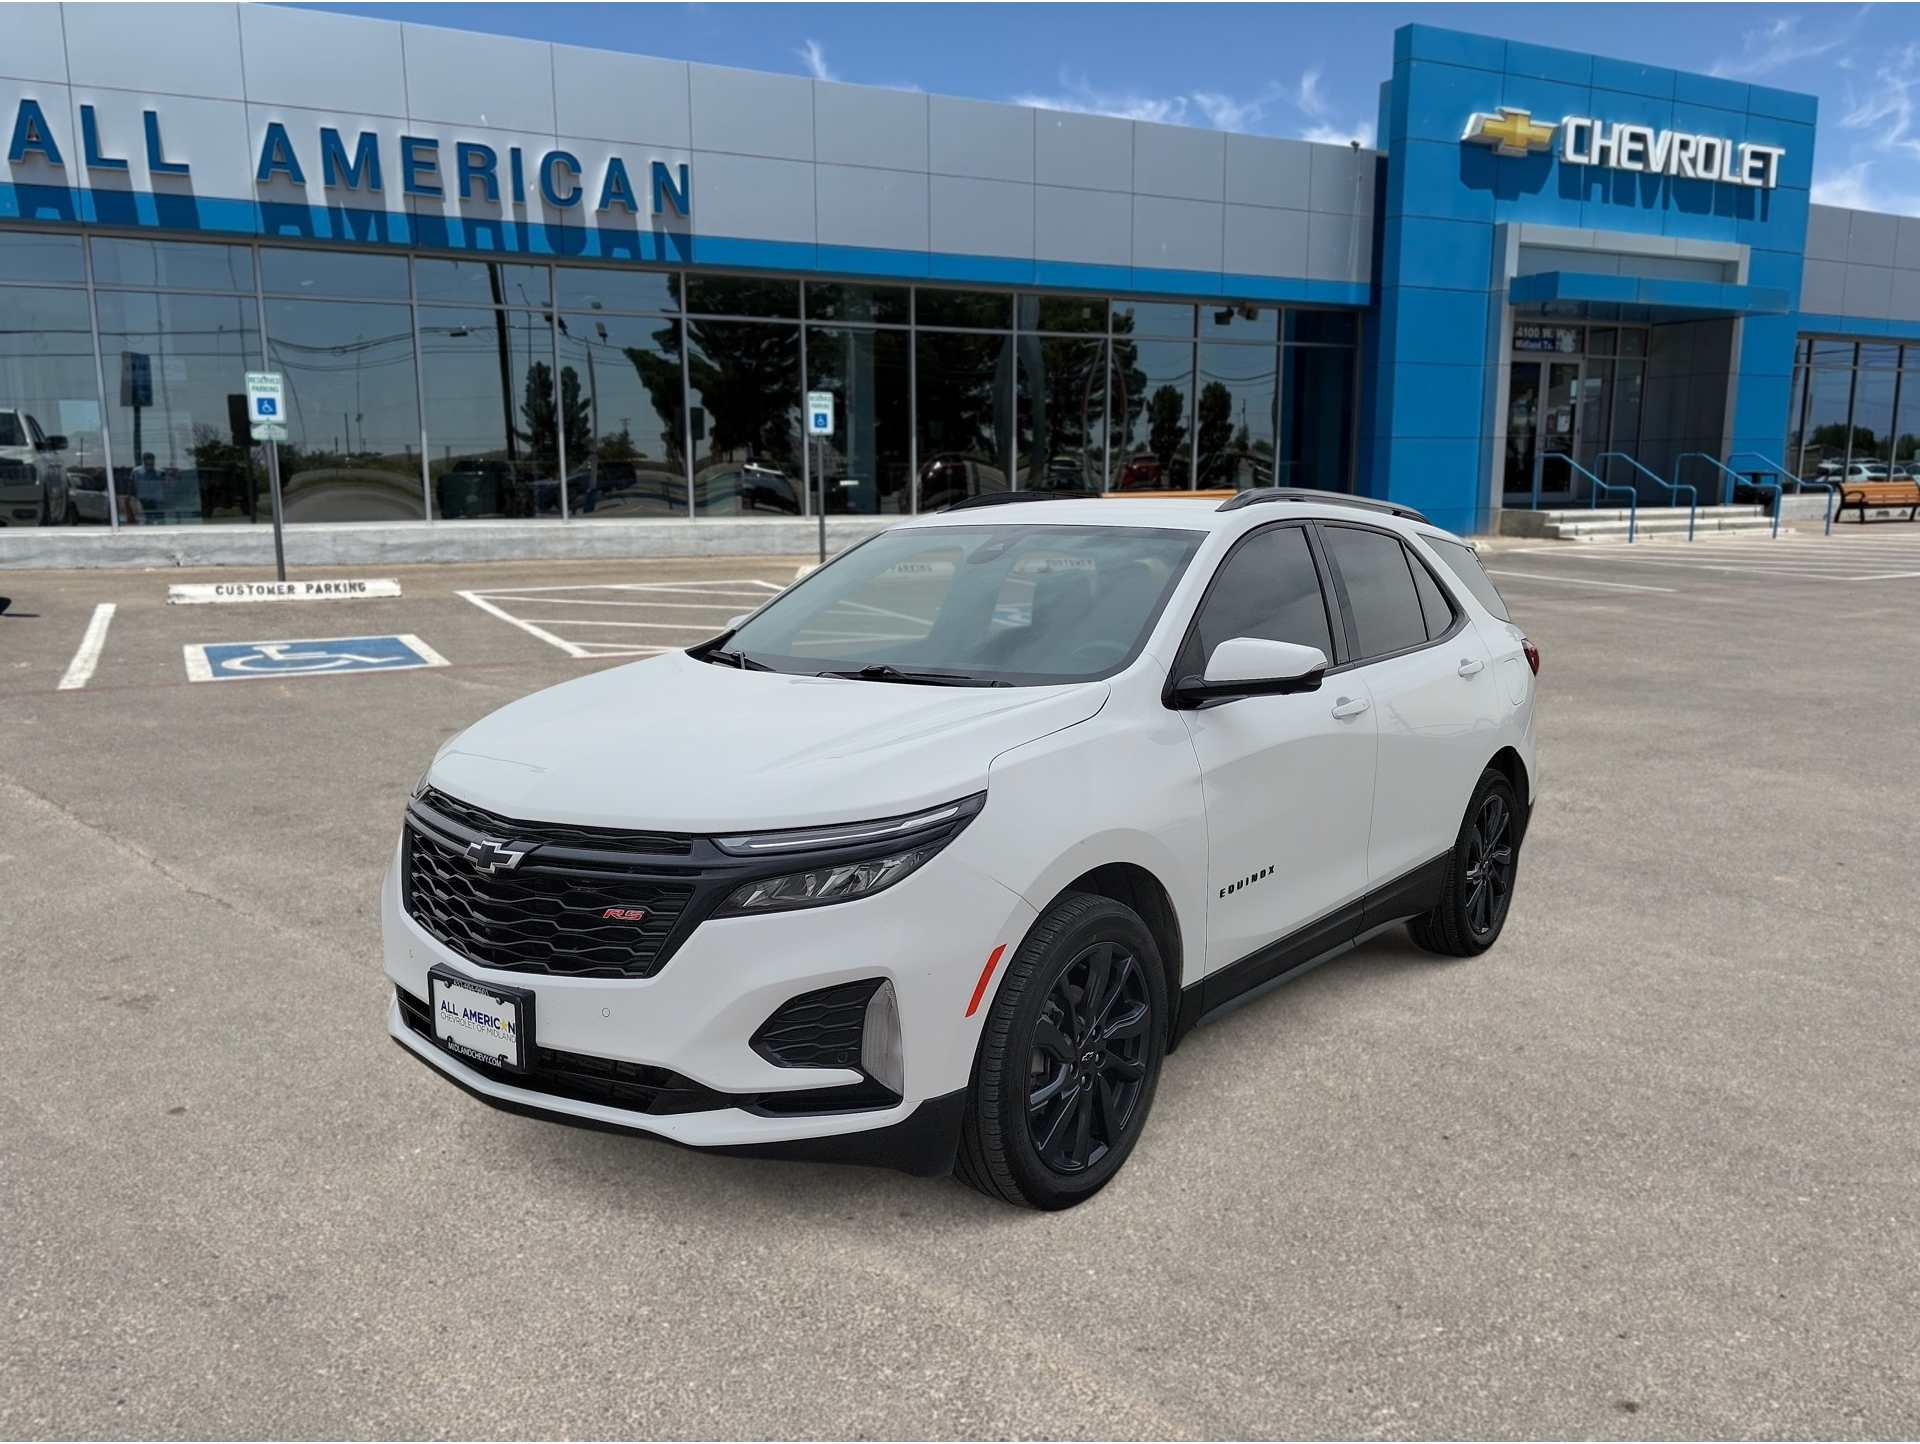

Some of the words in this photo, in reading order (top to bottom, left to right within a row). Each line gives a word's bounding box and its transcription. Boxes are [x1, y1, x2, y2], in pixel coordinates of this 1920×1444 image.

[8, 98, 190, 175] ALL
[256, 121, 691, 217] AMERICAN
[1560, 115, 1786, 189] CHEVROLET
[215, 585, 296, 596] CUSTOMER
[306, 582, 367, 594] PARKING
[1219, 865, 1275, 898] EQUINOX
[602, 908, 645, 921] RS
[440, 1000, 459, 1016] ALL
[462, 1008, 516, 1035] AMERICN
[440, 1011, 475, 1030] CHEVROLET
[476, 1025, 485, 1033] OF
[486, 1028, 516, 1043] MIDLAND
[448, 1042, 502, 1068] MIDLANDCHEVY.COM
